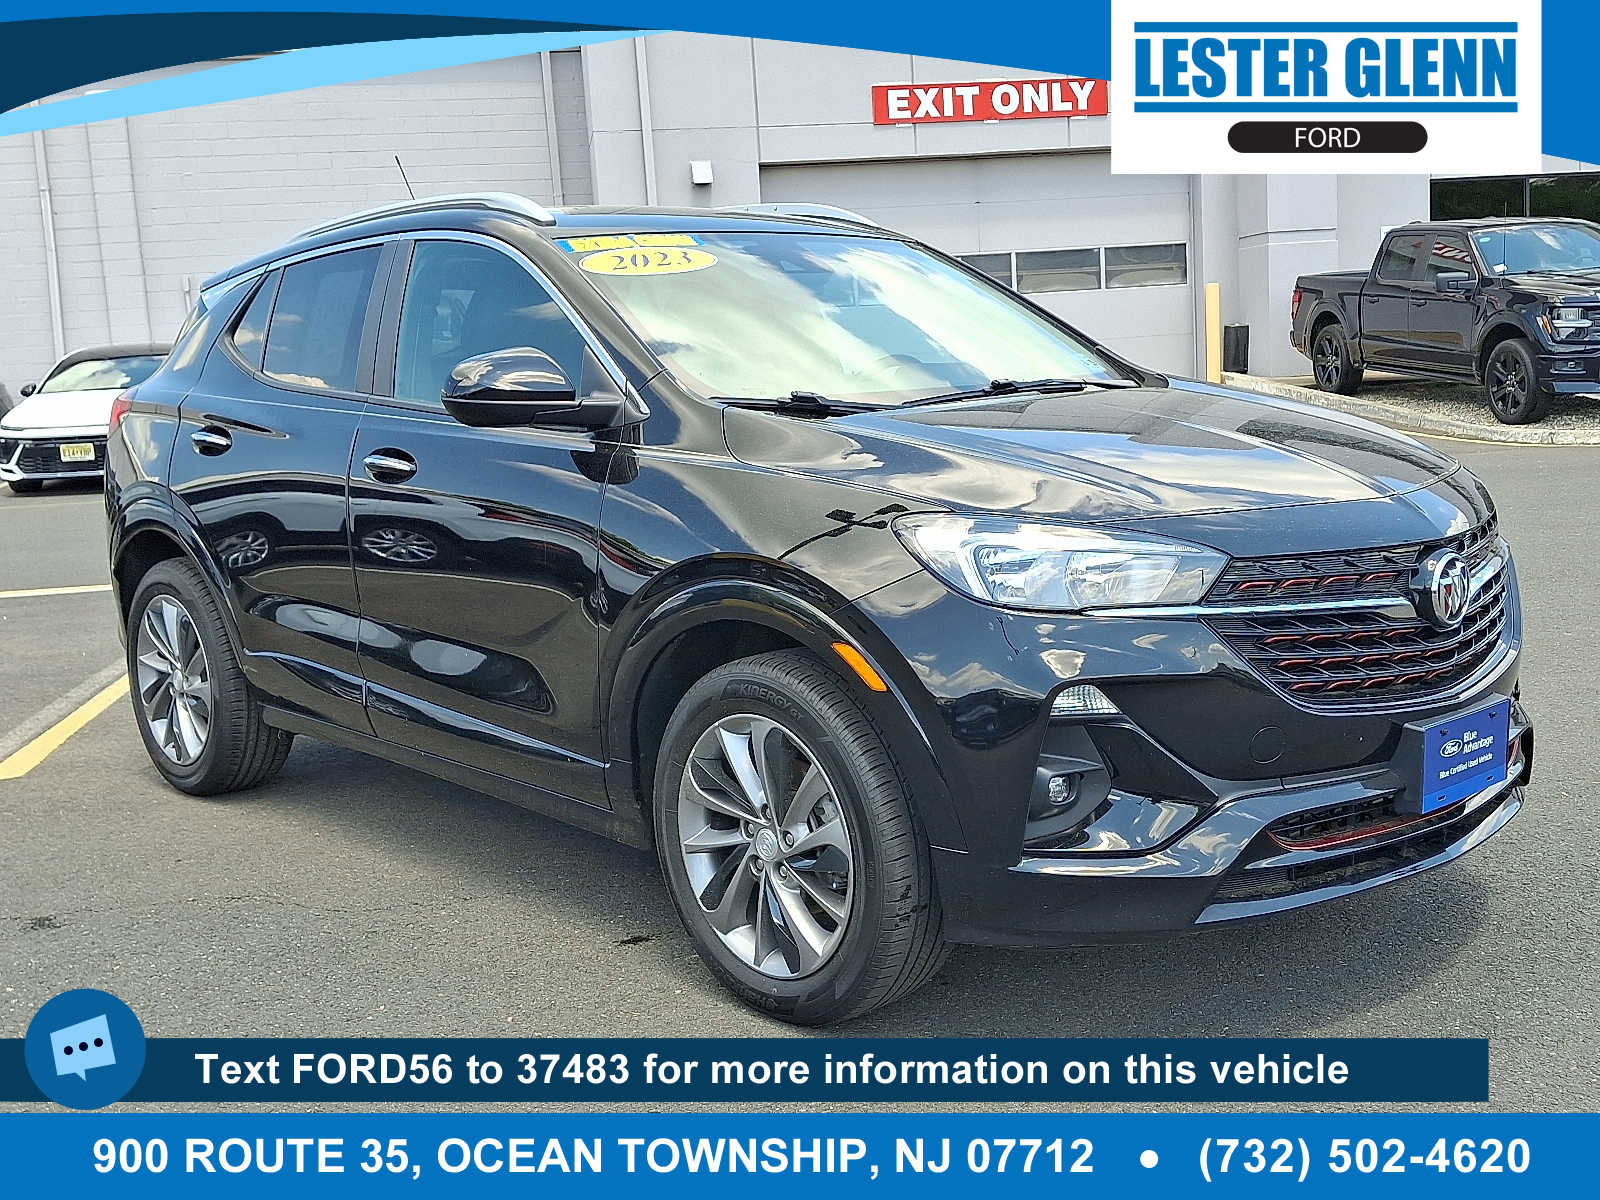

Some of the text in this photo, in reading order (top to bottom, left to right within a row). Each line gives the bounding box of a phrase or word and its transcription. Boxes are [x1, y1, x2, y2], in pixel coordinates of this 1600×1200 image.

[887, 80, 1096, 119] EXIT ONLY
[610, 251, 692, 270] 2023
[739, 683, 792, 709] KINERGY
[1463, 730, 1478, 743] Blue
[1463, 735, 1494, 755] Advantage
[1439, 752, 1493, 780] Blue Certified Used Vehicle
